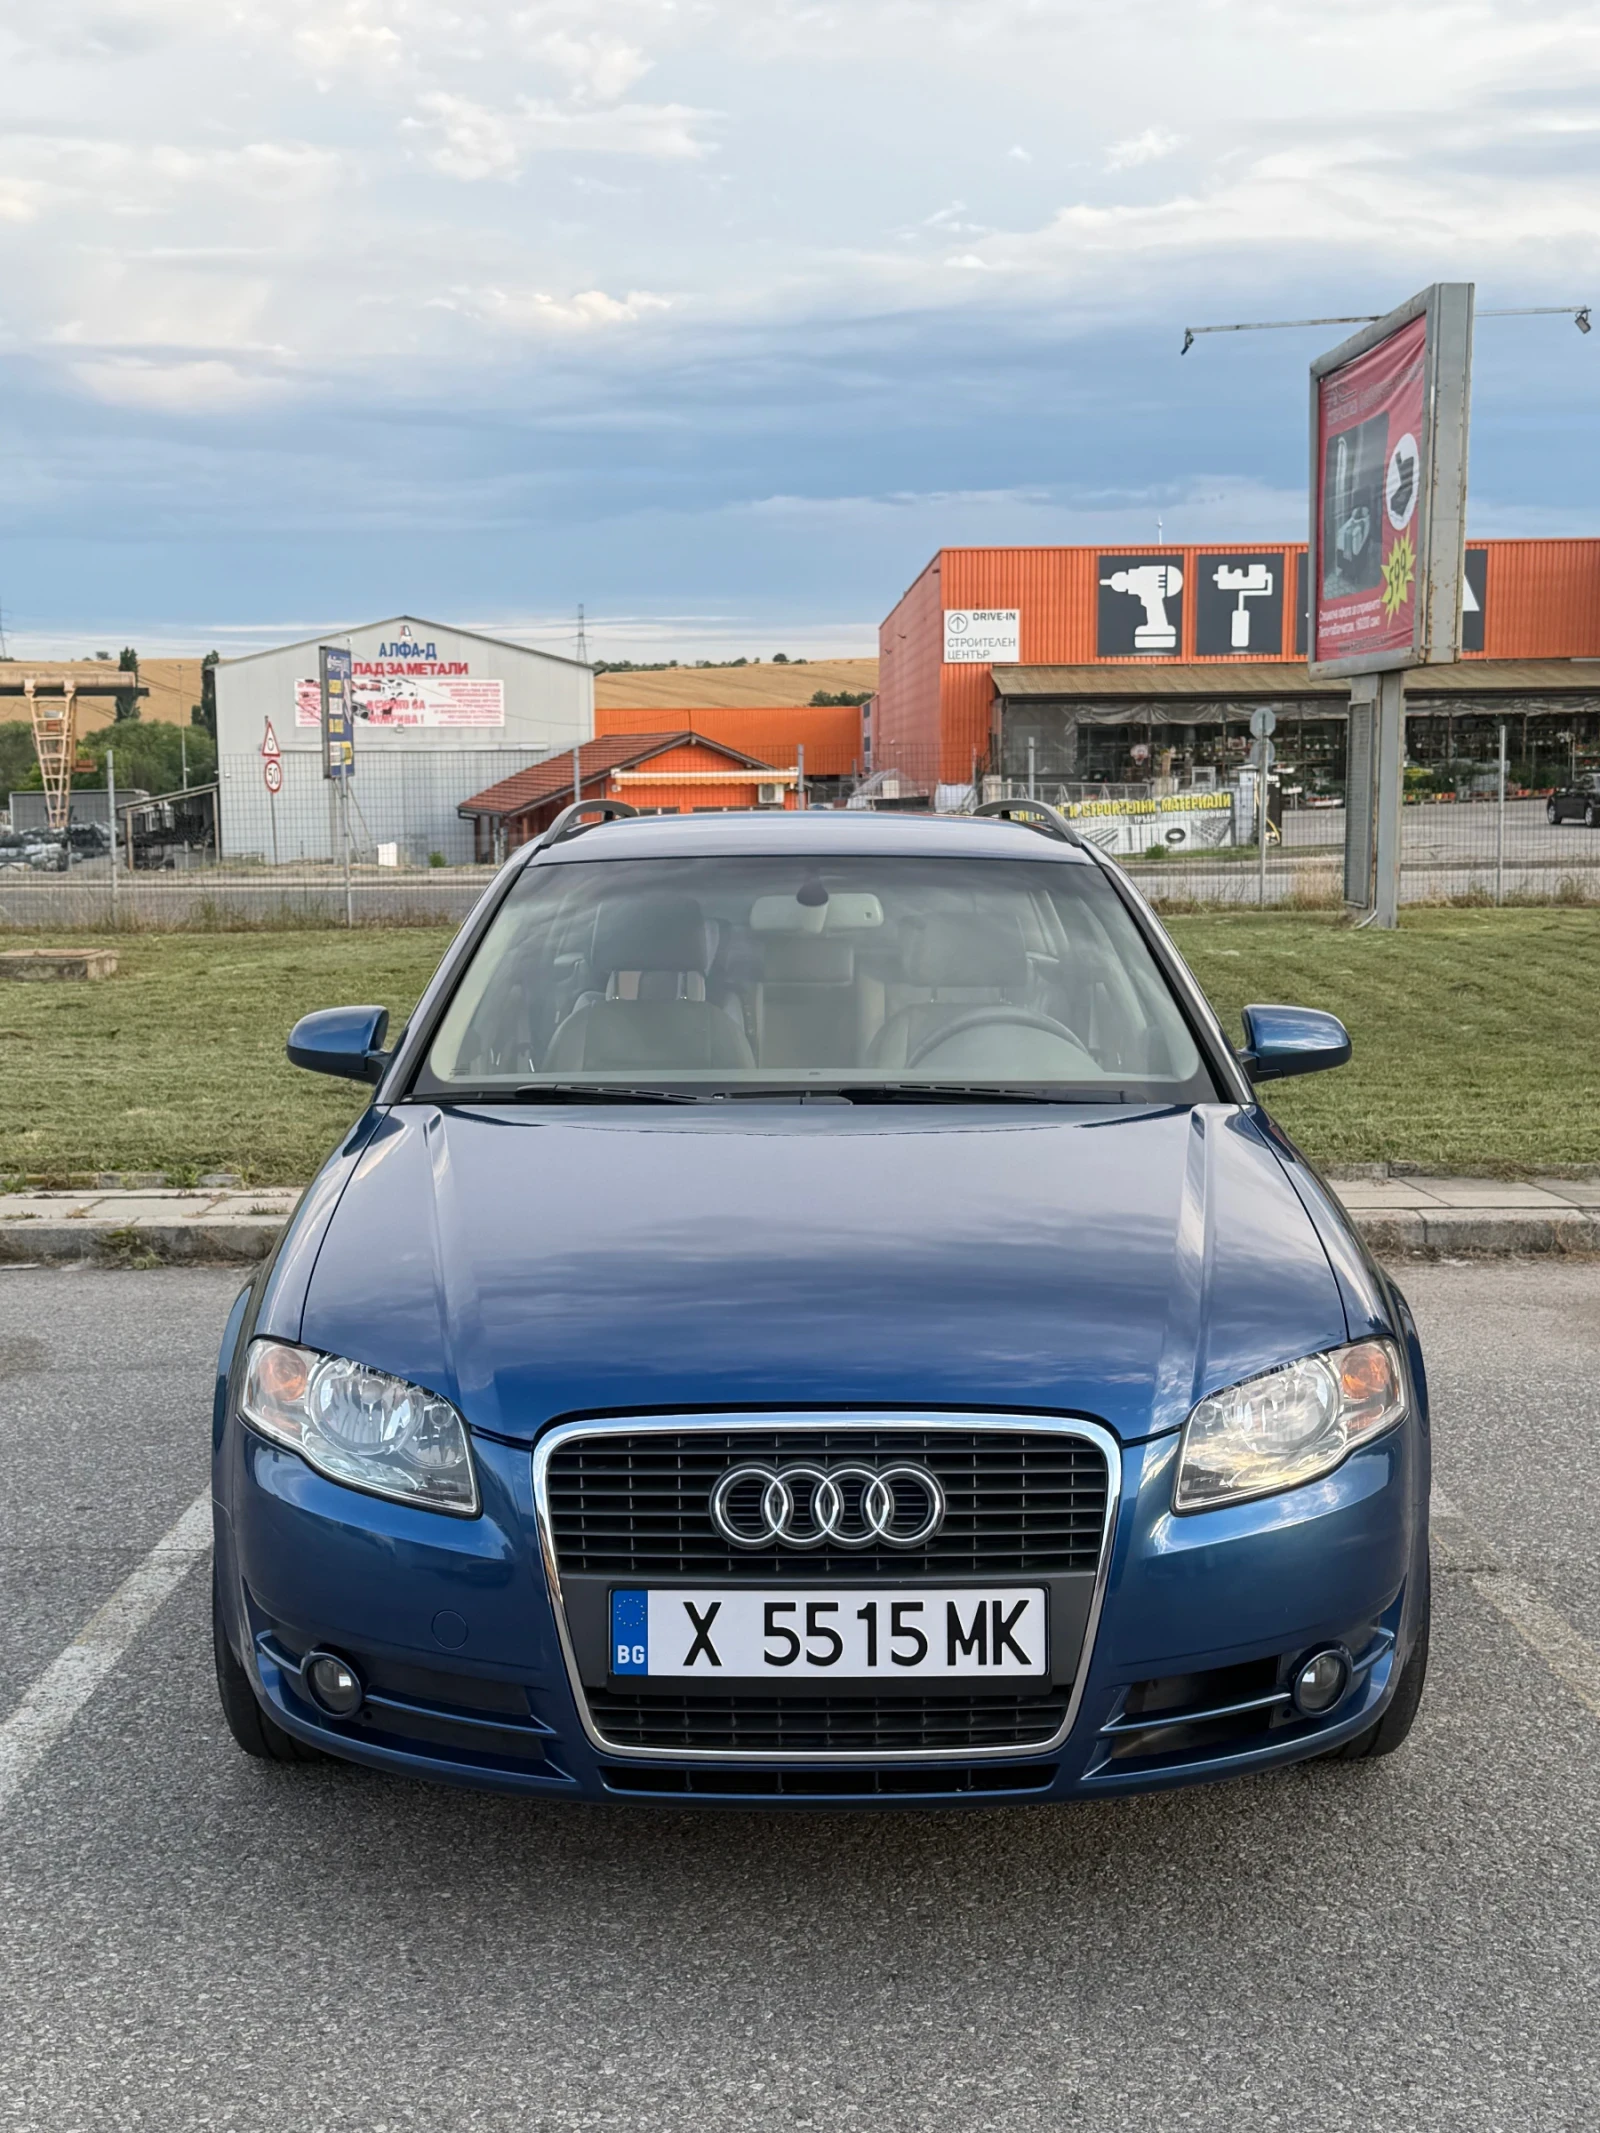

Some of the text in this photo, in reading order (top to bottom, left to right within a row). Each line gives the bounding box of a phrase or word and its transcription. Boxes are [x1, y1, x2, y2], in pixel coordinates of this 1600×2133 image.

[972, 612, 1016, 621] DRIVE-IN
[379, 642, 437, 660] АЛФА-Д
[947, 637, 1016, 648] СТРОИТЕЛЕН
[947, 650, 990, 660] ЦЕНТЪР
[352, 662, 385, 677] ЛАД
[386, 662, 405, 675] ЗА
[406, 662, 469, 676] МЕТАЛИ
[268, 767, 278, 784] 50
[1161, 793, 1232, 813] МАТЕРИАЛИ
[763, 1601, 929, 1667] 5515
[946, 1599, 1033, 1666] MK
[617, 1645, 645, 1664] BG
